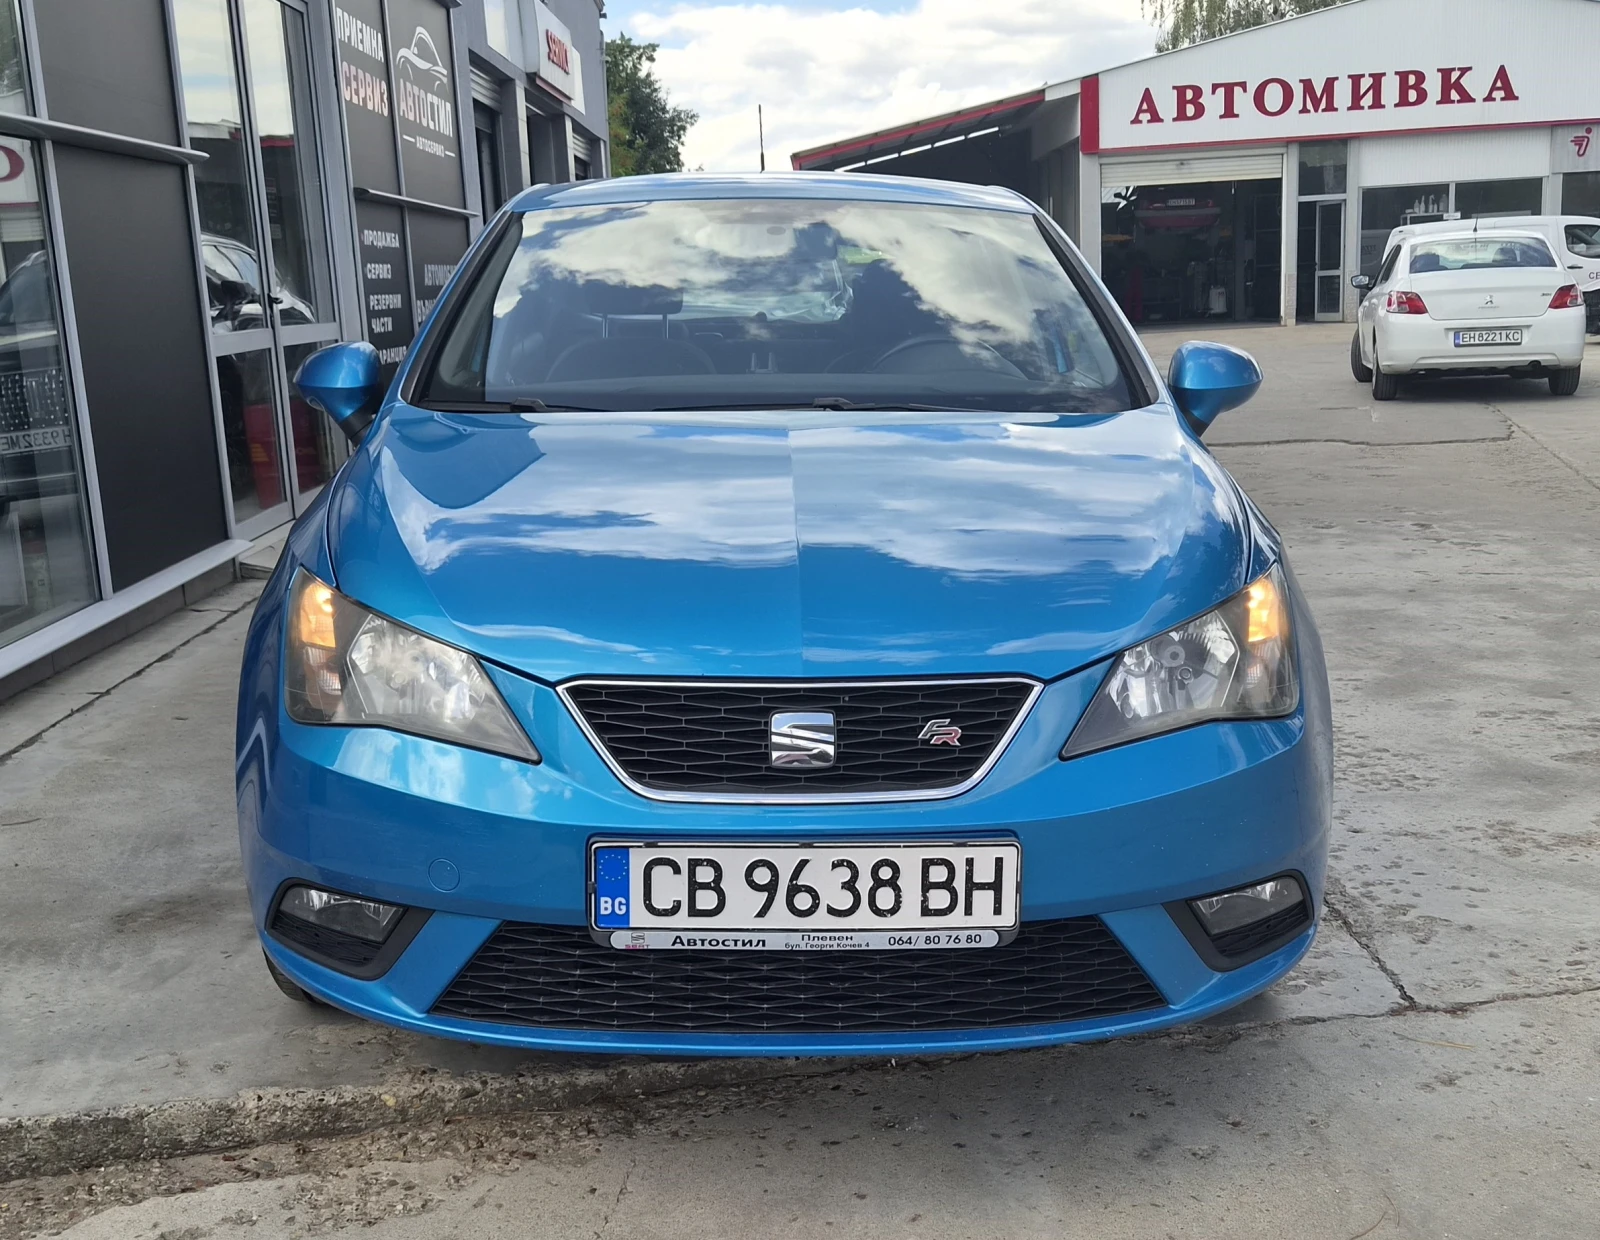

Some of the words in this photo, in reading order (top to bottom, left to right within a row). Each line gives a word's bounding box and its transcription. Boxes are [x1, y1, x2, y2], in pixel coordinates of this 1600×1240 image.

[336, 7, 384, 63] ПРИЕМНА
[341, 61, 389, 117] СЕРВИЗ
[1130, 64, 1519, 125] АВТОМИВКА
[400, 78, 453, 138] АВТОСТИЛ
[364, 229, 400, 249] ПРОДАЖБА
[366, 263, 392, 279] СЕРВИЗ
[370, 293, 402, 311] РЕЗЕРВНИ
[371, 317, 393, 333] ЧАСТИ
[1461, 333, 1476, 343] EH
[1477, 332, 1503, 342] 8221
[1505, 331, 1520, 341] KC
[377, 346, 407, 365] АРАНЦИЯ
[918, 718, 962, 746] FR
[600, 897, 627, 915] BG
[643, 857, 726, 917] CB
[744, 857, 903, 917] 9638
[921, 857, 1004, 917] BH
[671, 935, 767, 947] Автостил
[784, 942, 803, 950] бул.
[805, 942, 835, 950] Георги
[801, 934, 854, 942] Плевен
[888, 936, 920, 947] 064/
[924, 935, 941, 945] 80
[945, 934, 962, 945] 76
[965, 934, 982, 944] 80
